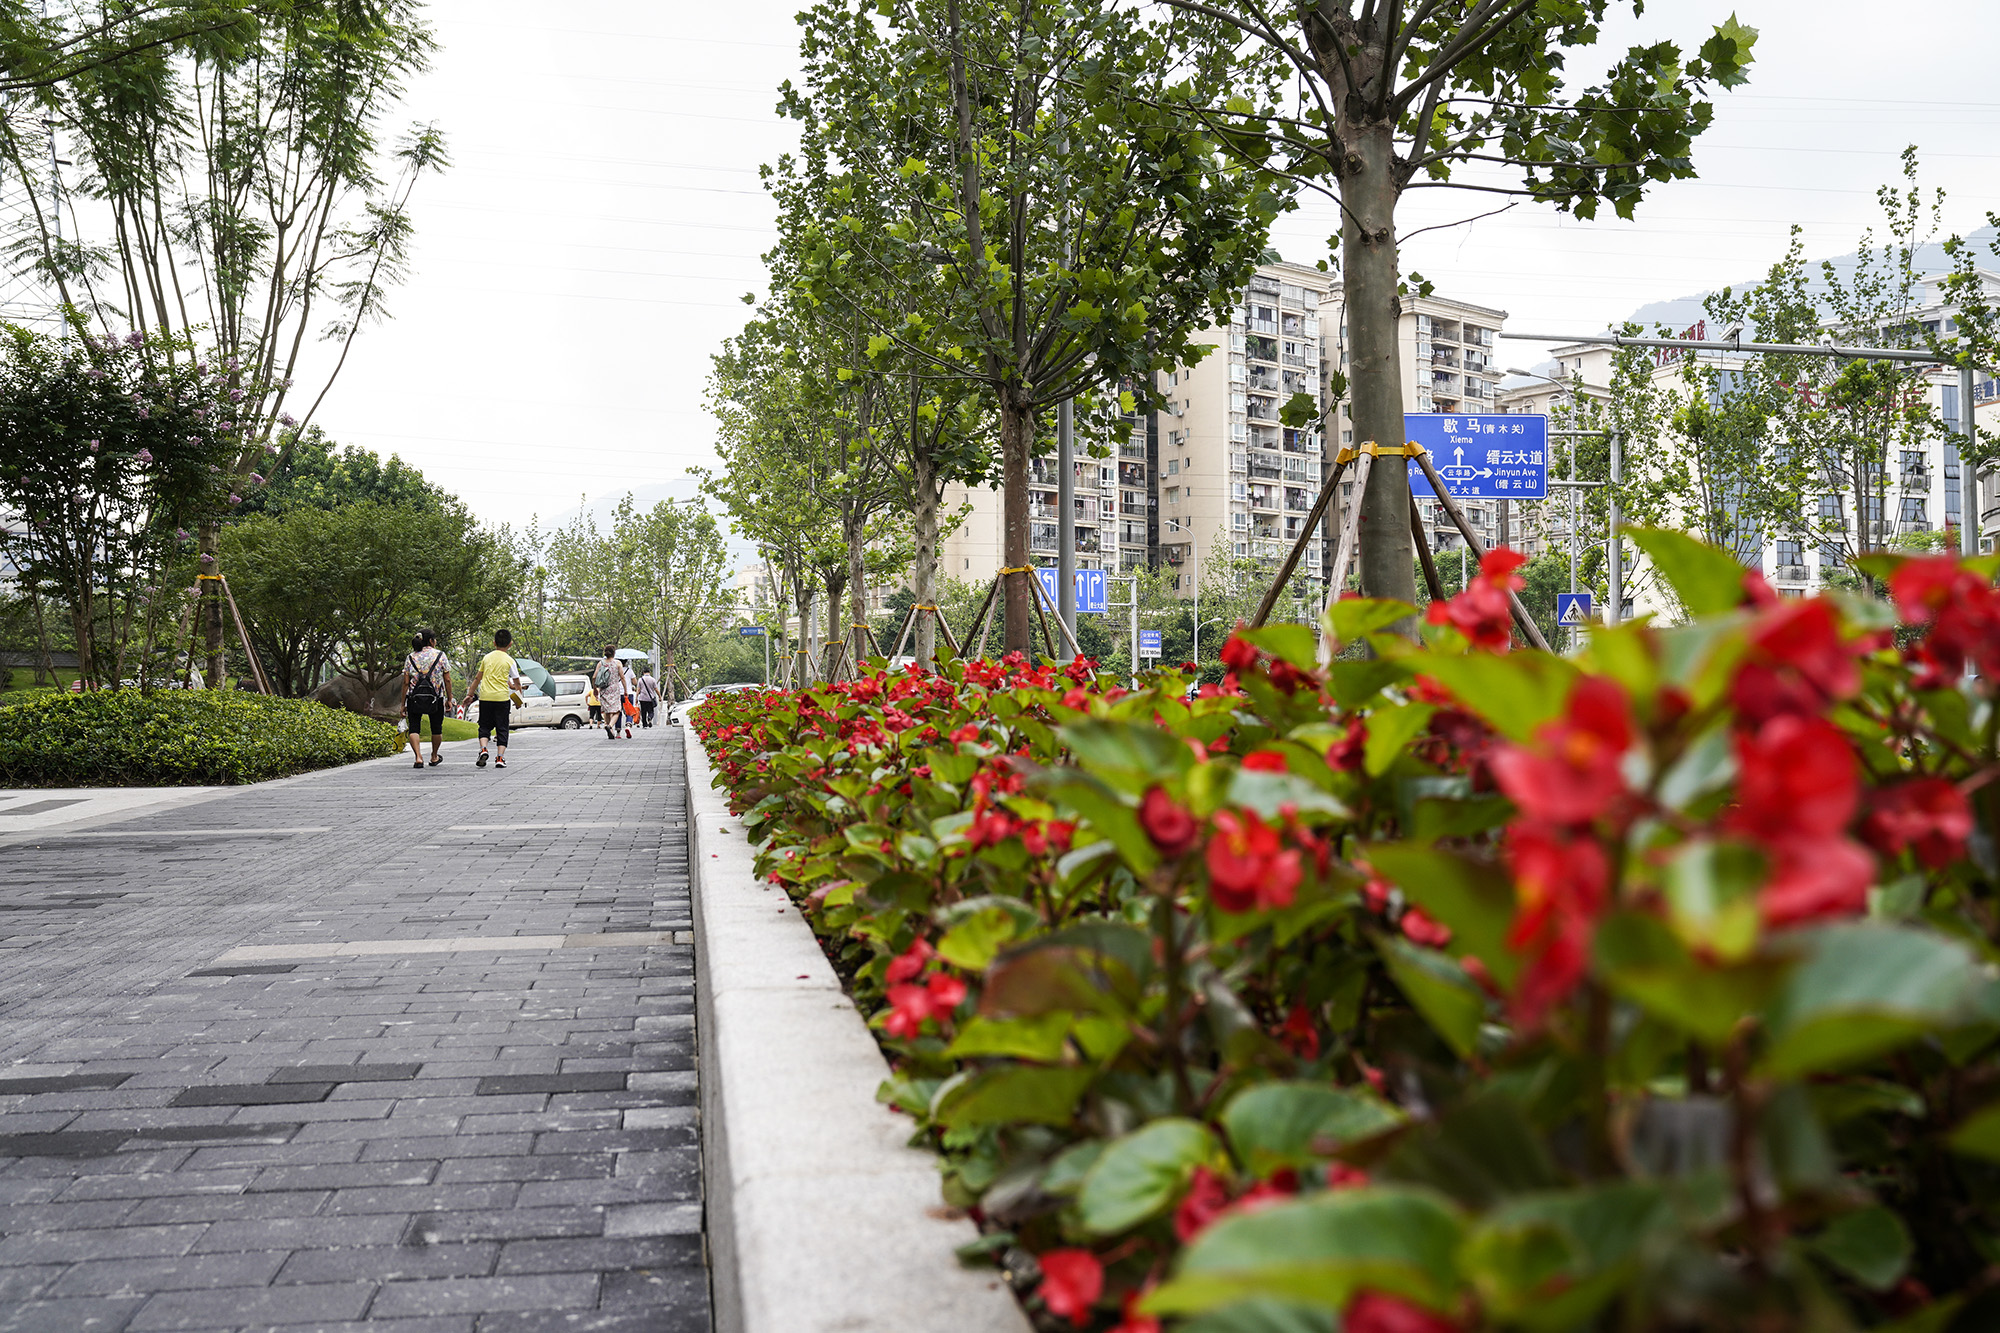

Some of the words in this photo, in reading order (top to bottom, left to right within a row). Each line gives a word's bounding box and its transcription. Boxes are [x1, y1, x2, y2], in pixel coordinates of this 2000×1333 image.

[1443, 418, 1480, 433] 歇马
[1482, 424, 1524, 434] (青木关)
[1450, 435, 1473, 444] Xiema
[1486, 449, 1544, 465] 缙云大道
[1447, 469, 1471, 477] 云华路
[1494, 468, 1520, 478] Jinyun
[1521, 468, 1539, 477] Ave.
[1494, 479, 1537, 490] (缙云山)
[1449, 486, 1481, 495] 元大道
